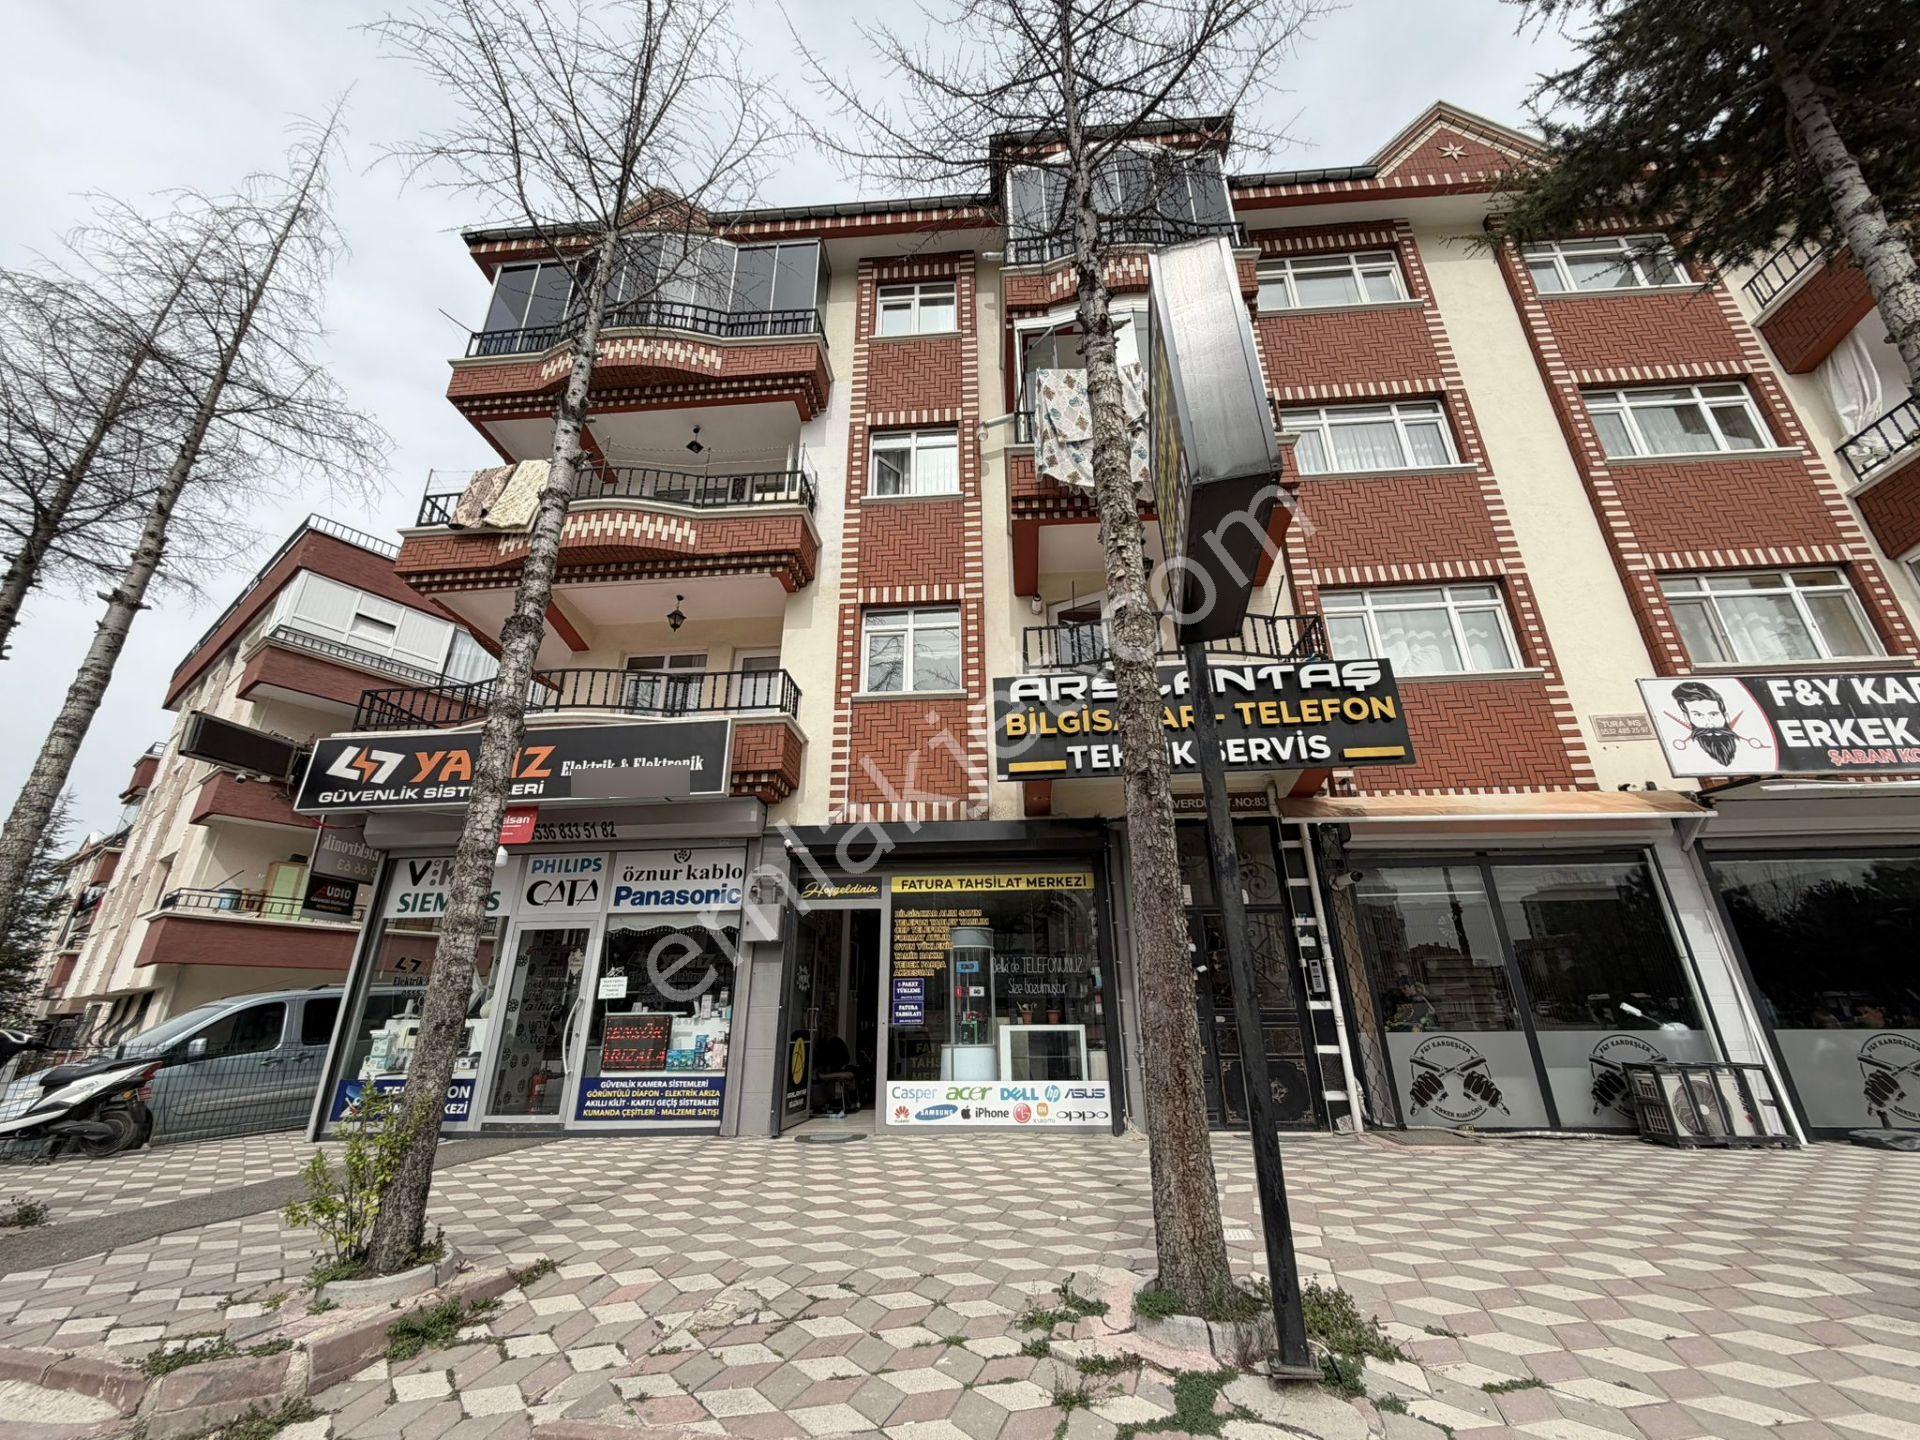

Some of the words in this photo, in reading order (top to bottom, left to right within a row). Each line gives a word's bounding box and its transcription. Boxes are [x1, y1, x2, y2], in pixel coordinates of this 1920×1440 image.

[1766, 678, 1841, 706] F&Y
[1006, 704, 1195, 736] BİLGİSAR
[1234, 696, 1396, 725] TELEFON
[1777, 717, 1920, 747] ERKEK
[1828, 748, 1897, 766] ŞABAN
[318, 785, 420, 803] GÜVENLİK
[531, 823, 556, 841] 536
[559, 822, 580, 840] 833
[584, 821, 597, 839] 51
[601, 820, 616, 838] 82
[531, 857, 602, 874] PHILIPS
[622, 865, 684, 883] öznur
[686, 863, 743, 881] kablo
[800, 881, 879, 899] Hoşgeldiniz
[901, 878, 953, 890] FATURA
[957, 875, 1022, 889] TAHSİLAT
[1026, 874, 1087, 888] MERKEZİ
[526, 878, 599, 907] CATA
[613, 883, 742, 907] Panasonic
[397, 891, 501, 913] SIEMS
[600, 1079, 635, 1088] GÜVENLİK
[668, 1079, 709, 1088] SİSTEMLERİ
[586, 1090, 630, 1098] GÖRÜNTÜLÜ
[632, 1089, 660, 1097] DİAFON
[665, 1089, 698, 1097] ELEKTRİK
[699, 1089, 720, 1097] ARIZA
[891, 1086, 938, 1102] Casper
[945, 1086, 992, 1101] acer
[1000, 1087, 1040, 1101] DELL
[1064, 1088, 1105, 1099] ASUS
[608, 1099, 626, 1107] KİLİT
[631, 1099, 655, 1107] KARTLI
[656, 1099, 678, 1108] GEÇİŞ
[583, 1109, 620, 1117] KUMANDA
[621, 1108, 656, 1118] ÇEŞİTLERİ
[661, 1108, 696, 1116] MALZEME
[697, 1108, 720, 1117] SATIŞI
[975, 1107, 1010, 1120] iPhone
[1056, 1110, 1109, 1121] oppo
